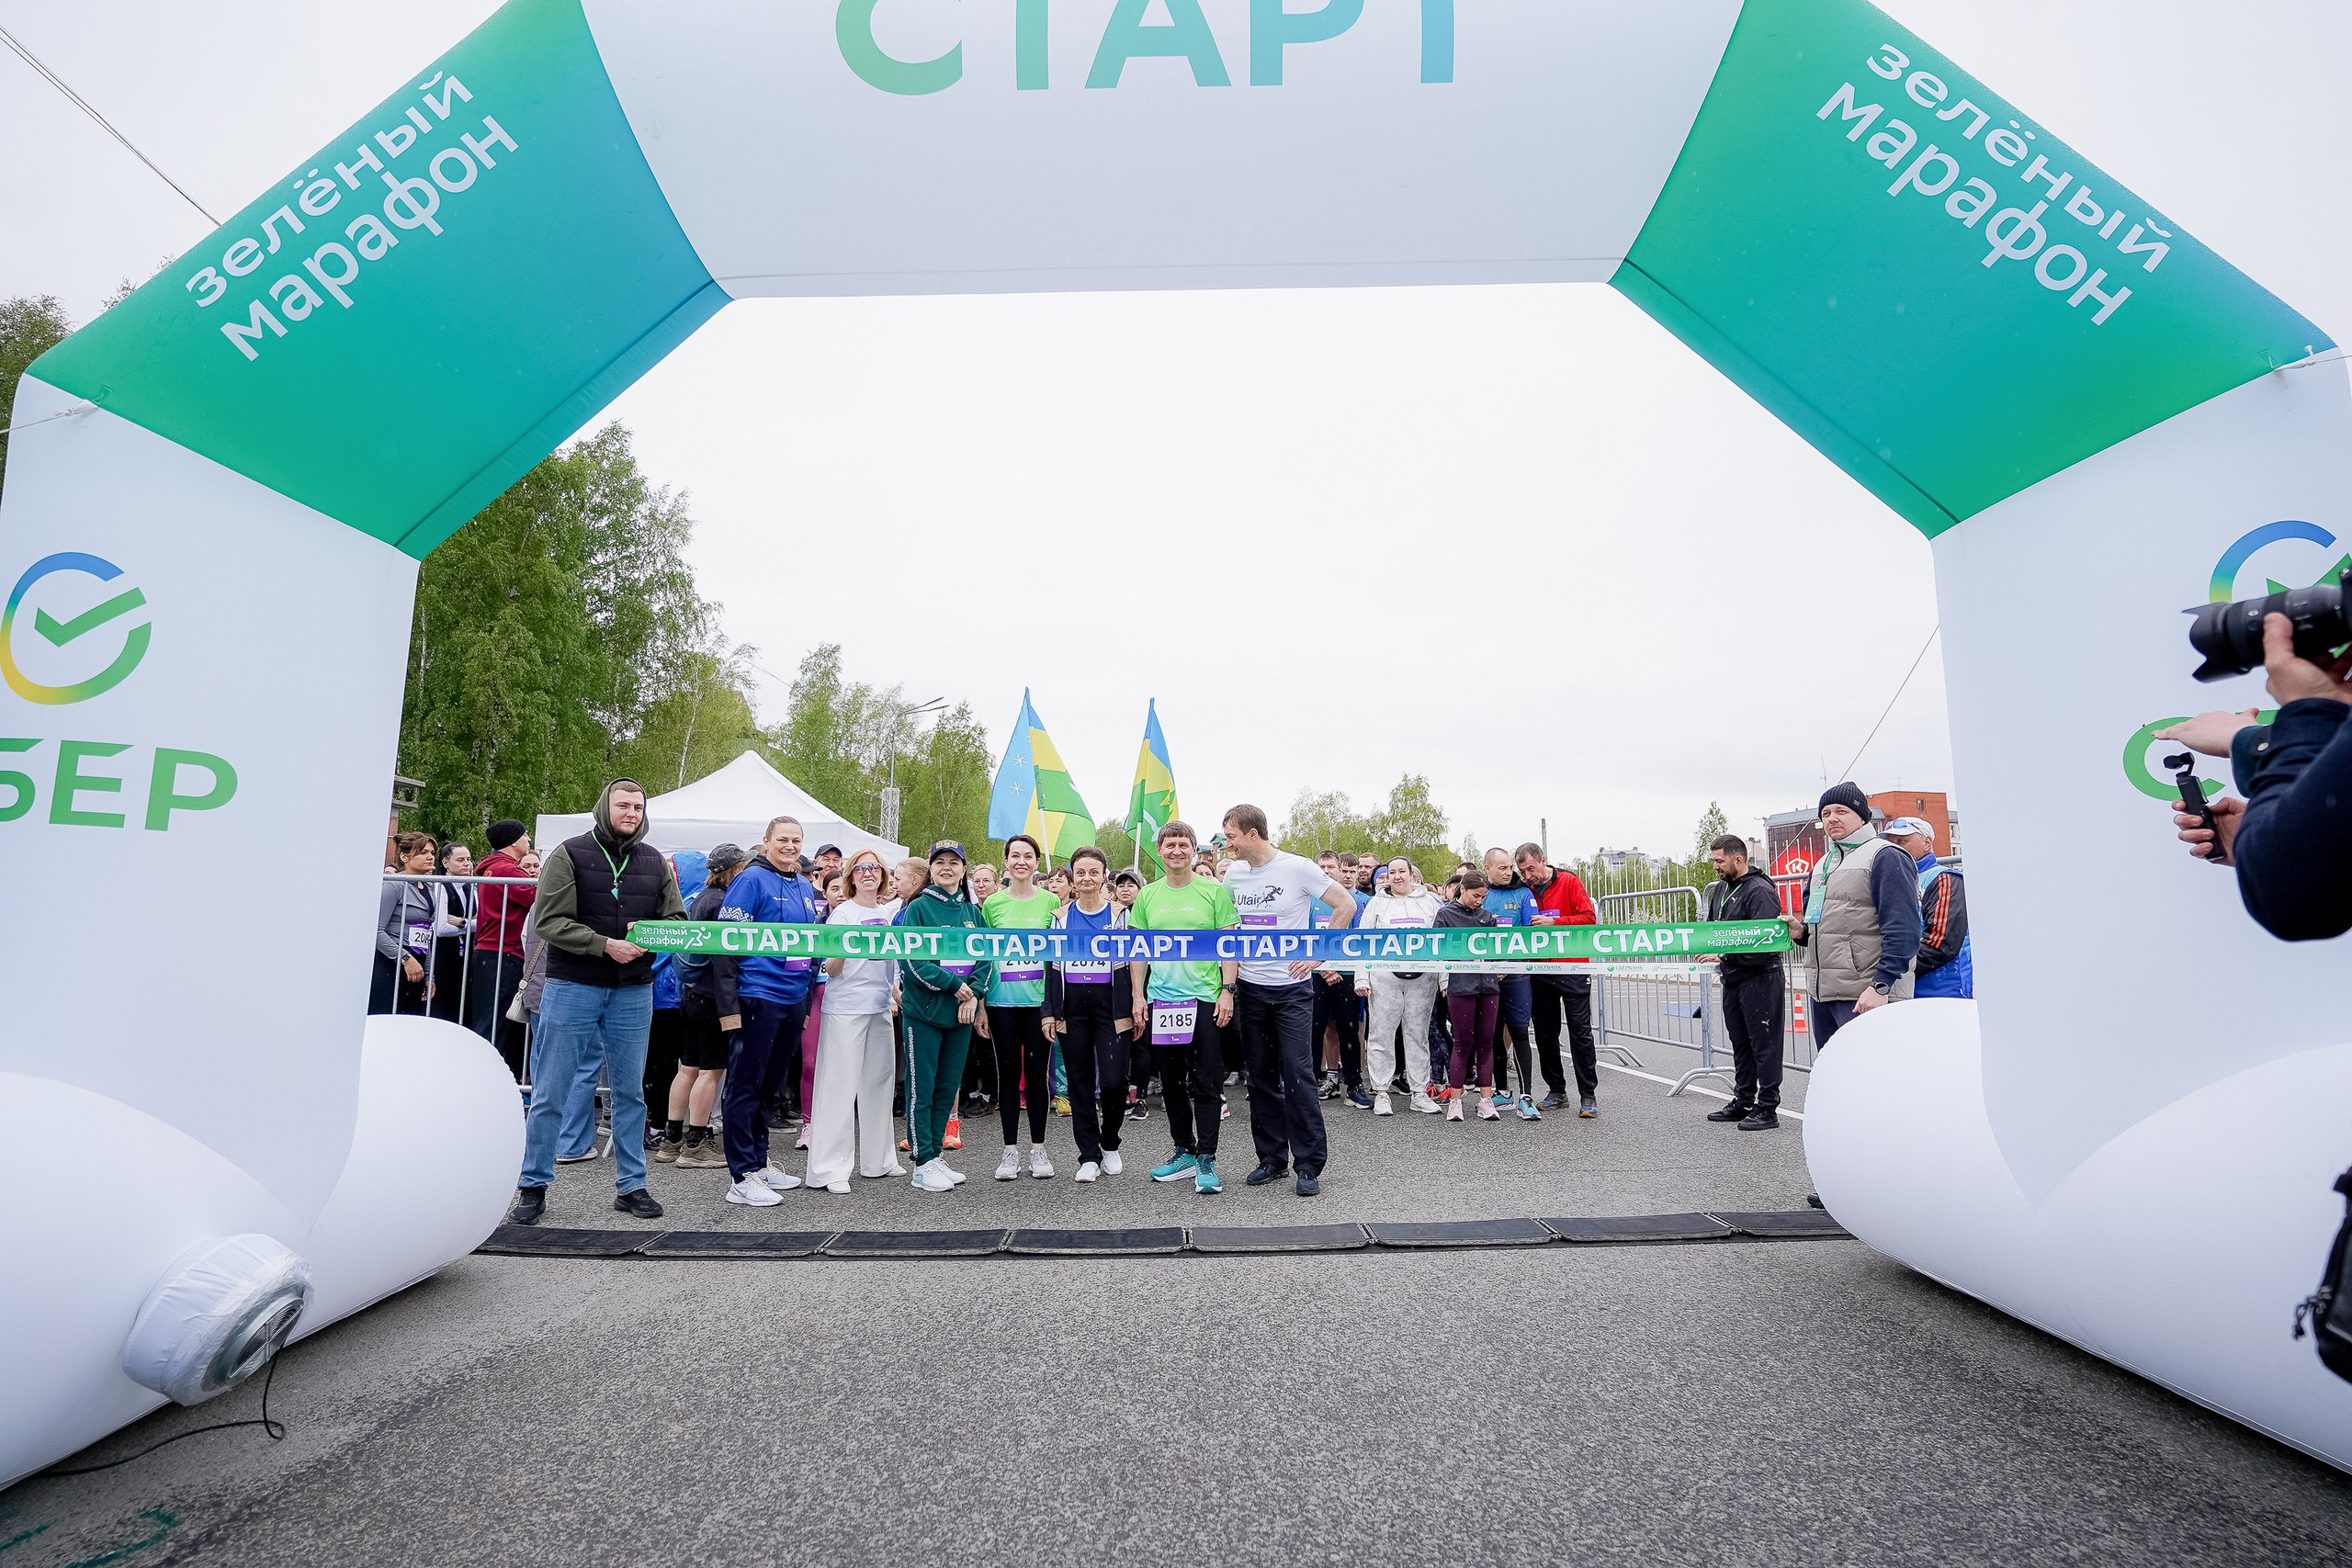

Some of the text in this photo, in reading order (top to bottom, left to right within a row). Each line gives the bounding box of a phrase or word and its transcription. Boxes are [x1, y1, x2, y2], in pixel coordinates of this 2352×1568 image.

[1866, 43, 2172, 273] зелёный
[186, 70, 474, 307] зелёный
[1815, 82, 2132, 326] марафон
[220, 116, 519, 361] марафон
[1237, 895, 1261, 906] Utair
[641, 925, 688, 935] зелёный
[1713, 925, 1761, 937] зелёный
[636, 935, 684, 947] марафон
[721, 928, 1694, 958] СТАРТ СТАРТ СТАРТ СТАРТ СТАРТ СТАРТ СТАРТ СТАРТ
[1707, 937, 1756, 948] марафон
[1159, 1013, 1193, 1028] 2185
